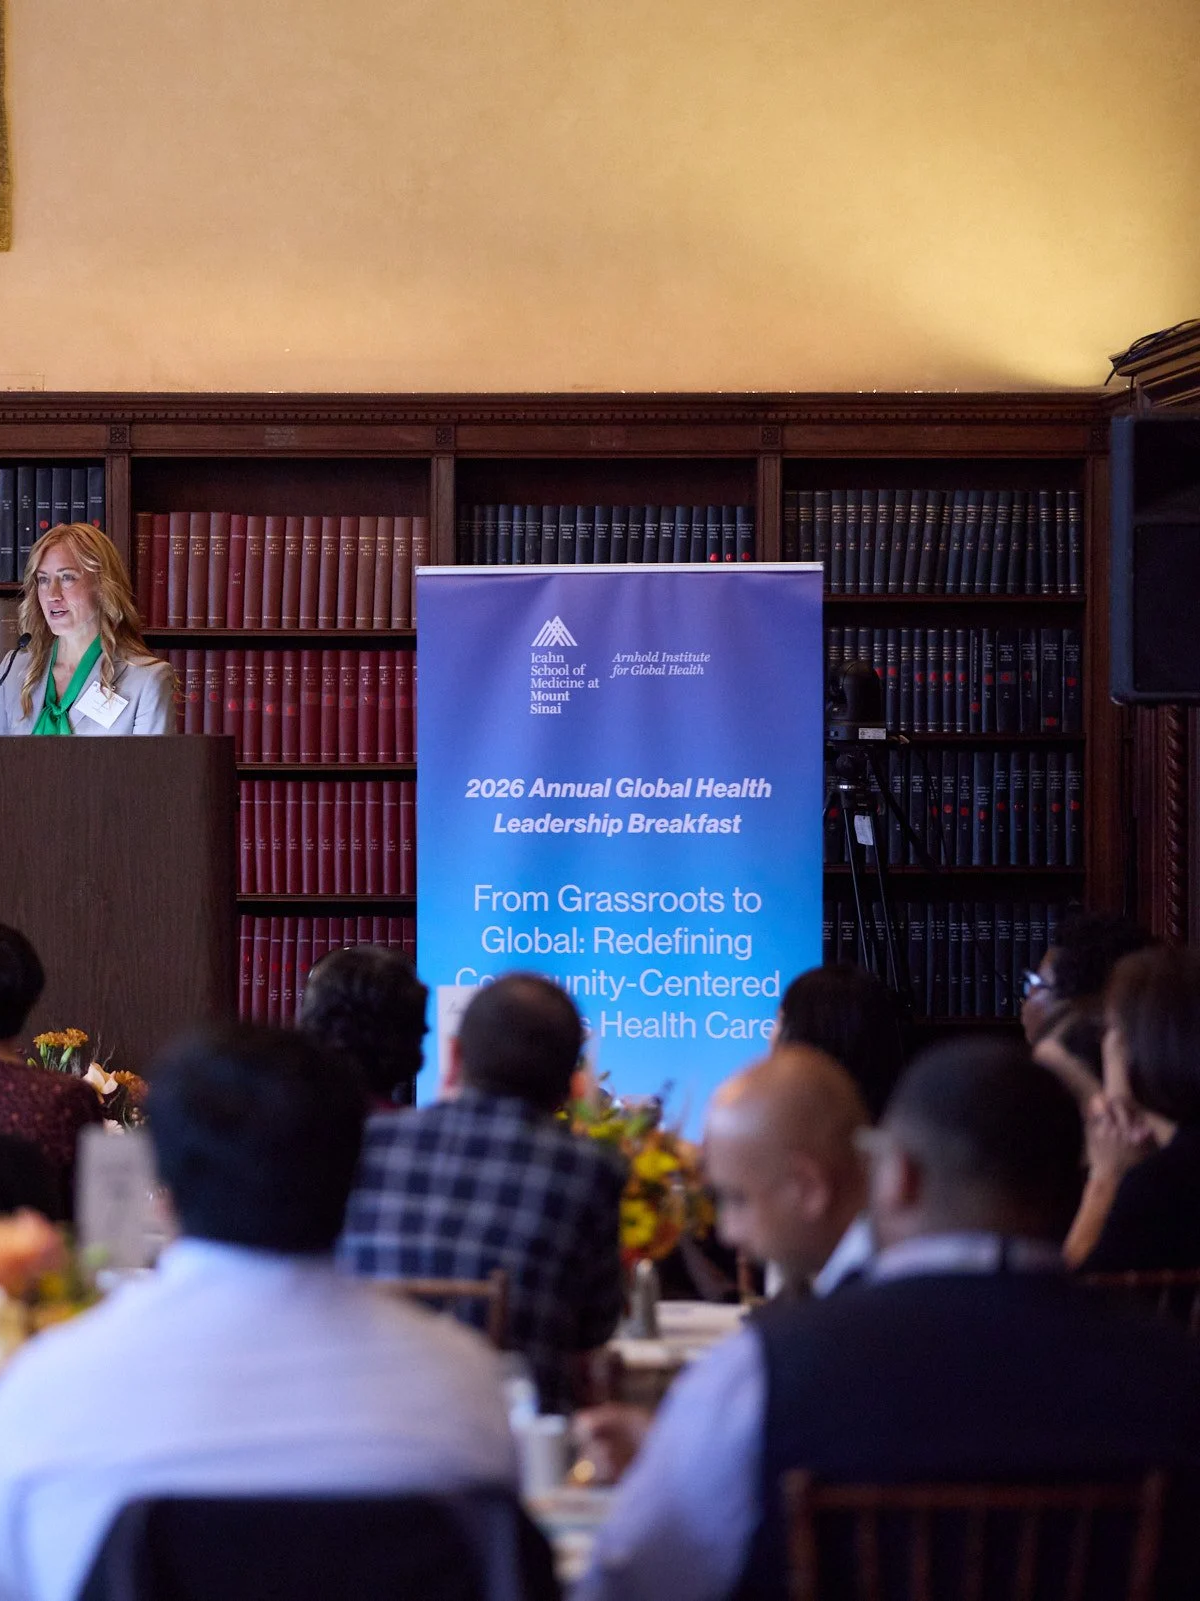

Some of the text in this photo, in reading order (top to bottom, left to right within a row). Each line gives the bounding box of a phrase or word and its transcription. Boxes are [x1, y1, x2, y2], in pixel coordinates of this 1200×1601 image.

[530, 651, 564, 663] Icahn
[612, 652, 711, 663] Arnhold Institute
[530, 664, 586, 676] School of
[609, 664, 704, 679] for Global Health
[530, 677, 600, 689] Medicine at
[530, 690, 570, 701] Mount
[530, 702, 562, 714] Sinai
[465, 777, 773, 799] 2026 Annual Global Health
[493, 813, 743, 837] Leadership Breakfast
[474, 884, 763, 914] From Grassroots to
[480, 926, 754, 961] Global: Redefining
[455, 967, 780, 1002] Counity-Centered
[600, 1010, 697, 1039] Health
[705, 1010, 779, 1040] Care
